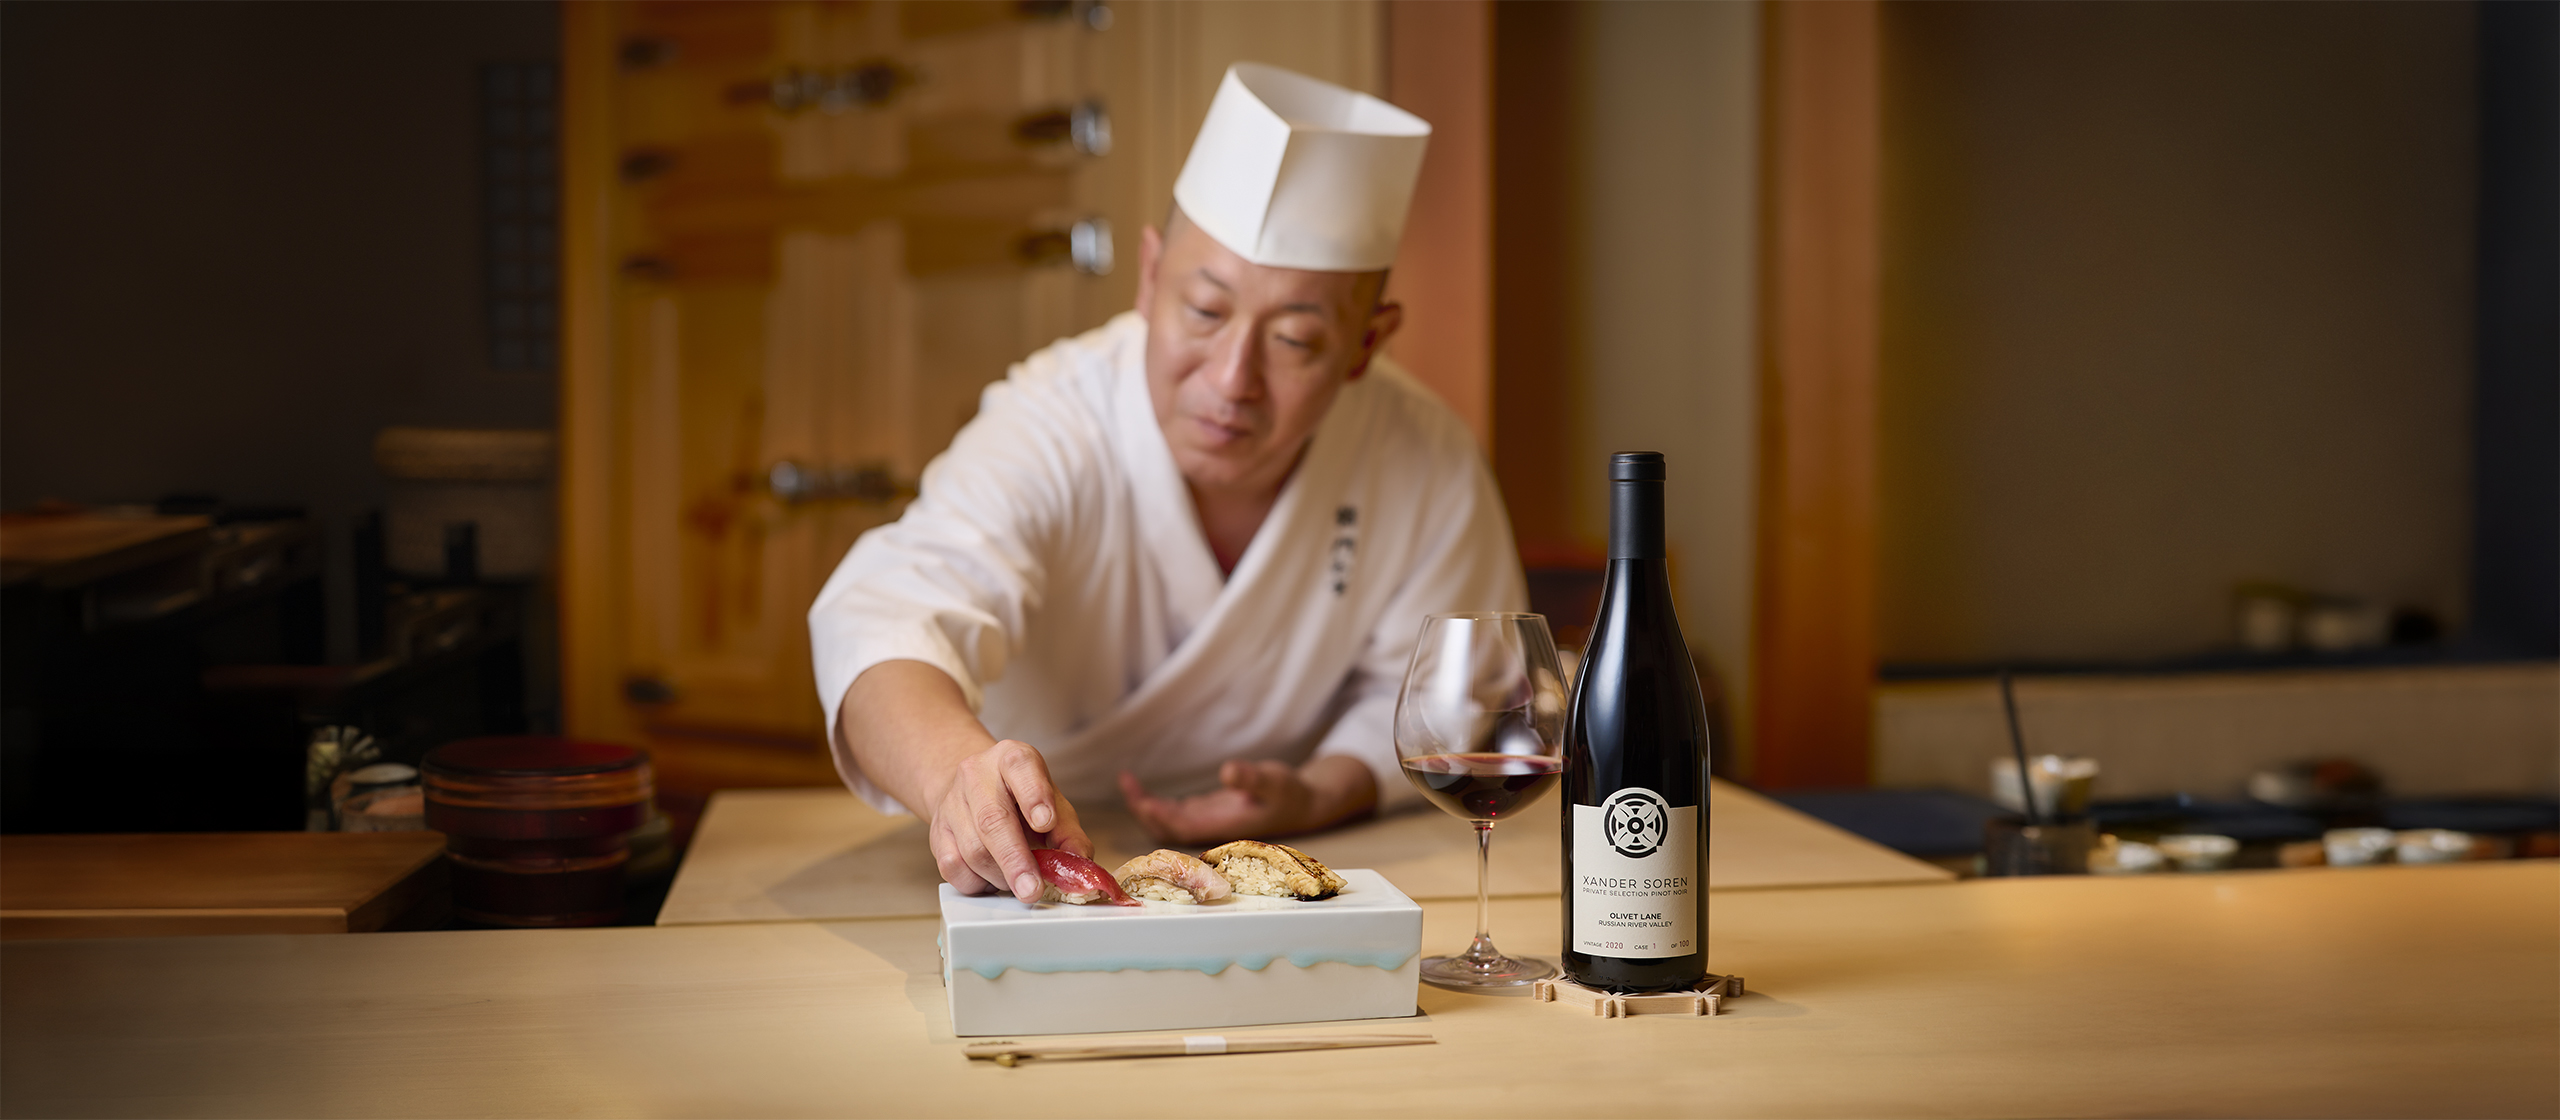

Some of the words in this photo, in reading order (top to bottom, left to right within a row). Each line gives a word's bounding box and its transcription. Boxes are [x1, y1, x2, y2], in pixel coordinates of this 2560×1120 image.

[1583, 875, 1637, 889] XANDER
[1643, 877, 1688, 889] SOREN
[1583, 888, 1607, 896] PRIVATE
[1609, 912, 1638, 920] OLIVET
[1649, 920, 1673, 928] VALLEY
[1605, 941, 1624, 949] 2020
